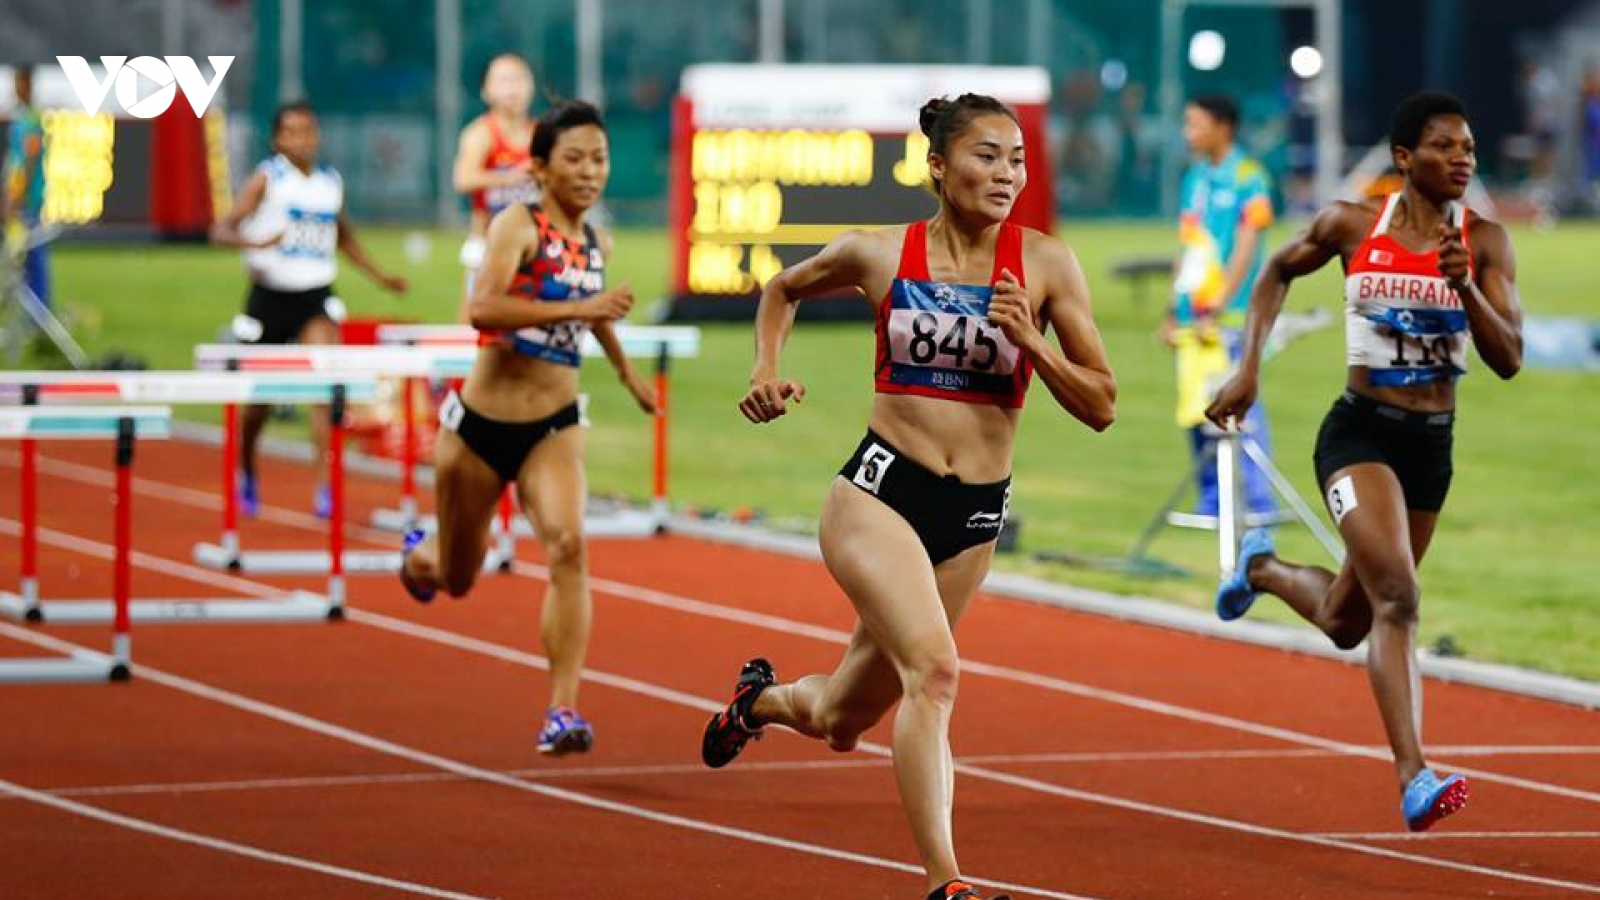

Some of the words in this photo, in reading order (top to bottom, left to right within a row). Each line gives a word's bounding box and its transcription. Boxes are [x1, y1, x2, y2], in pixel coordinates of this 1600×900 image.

[1358, 276, 1462, 311] BAHRAIN
[909, 312, 998, 371] 845
[864, 451, 888, 483] 5
[1331, 487, 1344, 516] 3
